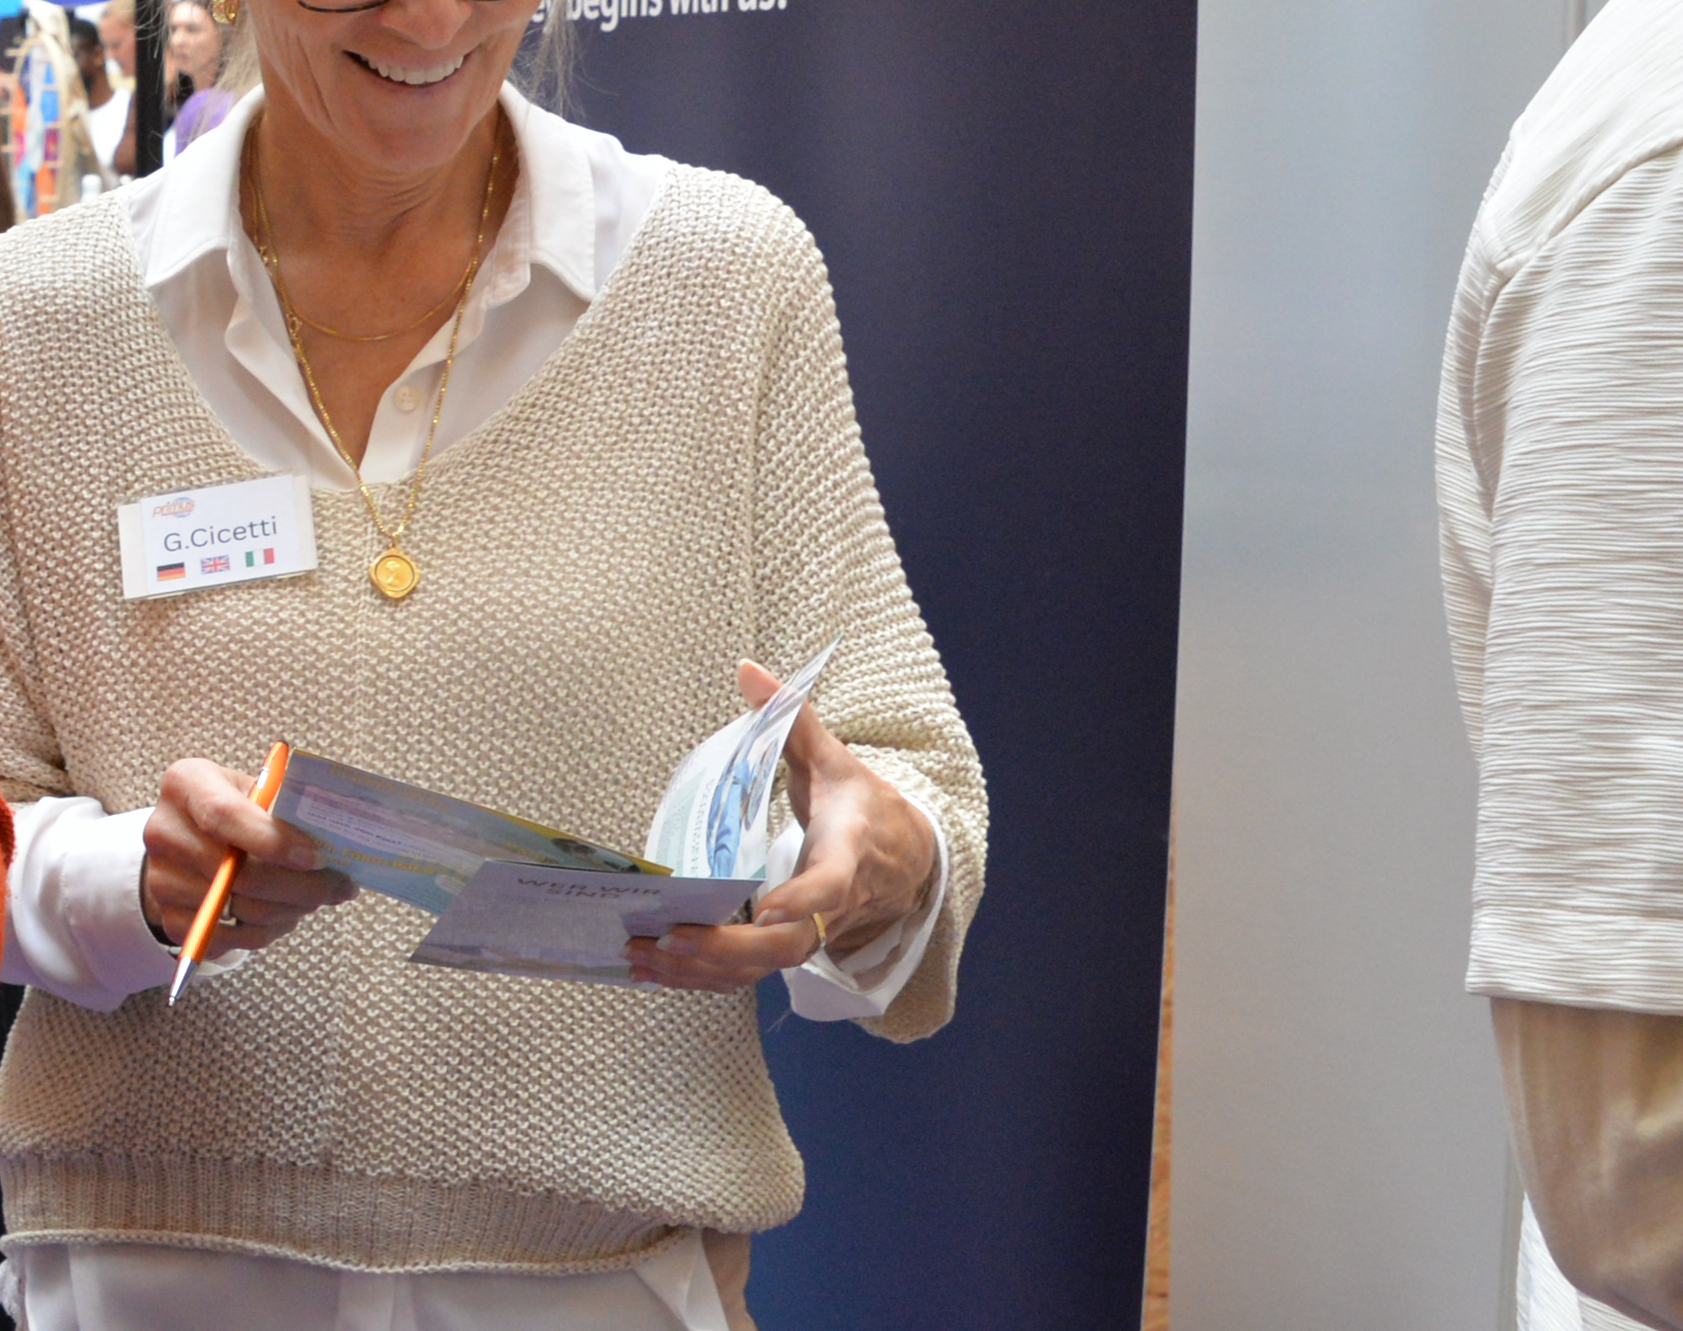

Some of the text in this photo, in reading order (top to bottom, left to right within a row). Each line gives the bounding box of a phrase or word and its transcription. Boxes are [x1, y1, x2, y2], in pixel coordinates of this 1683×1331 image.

[163, 516, 278, 552] G.Cicetti
[517, 878, 662, 896] WER WIR
[546, 888, 621, 899] SIND
